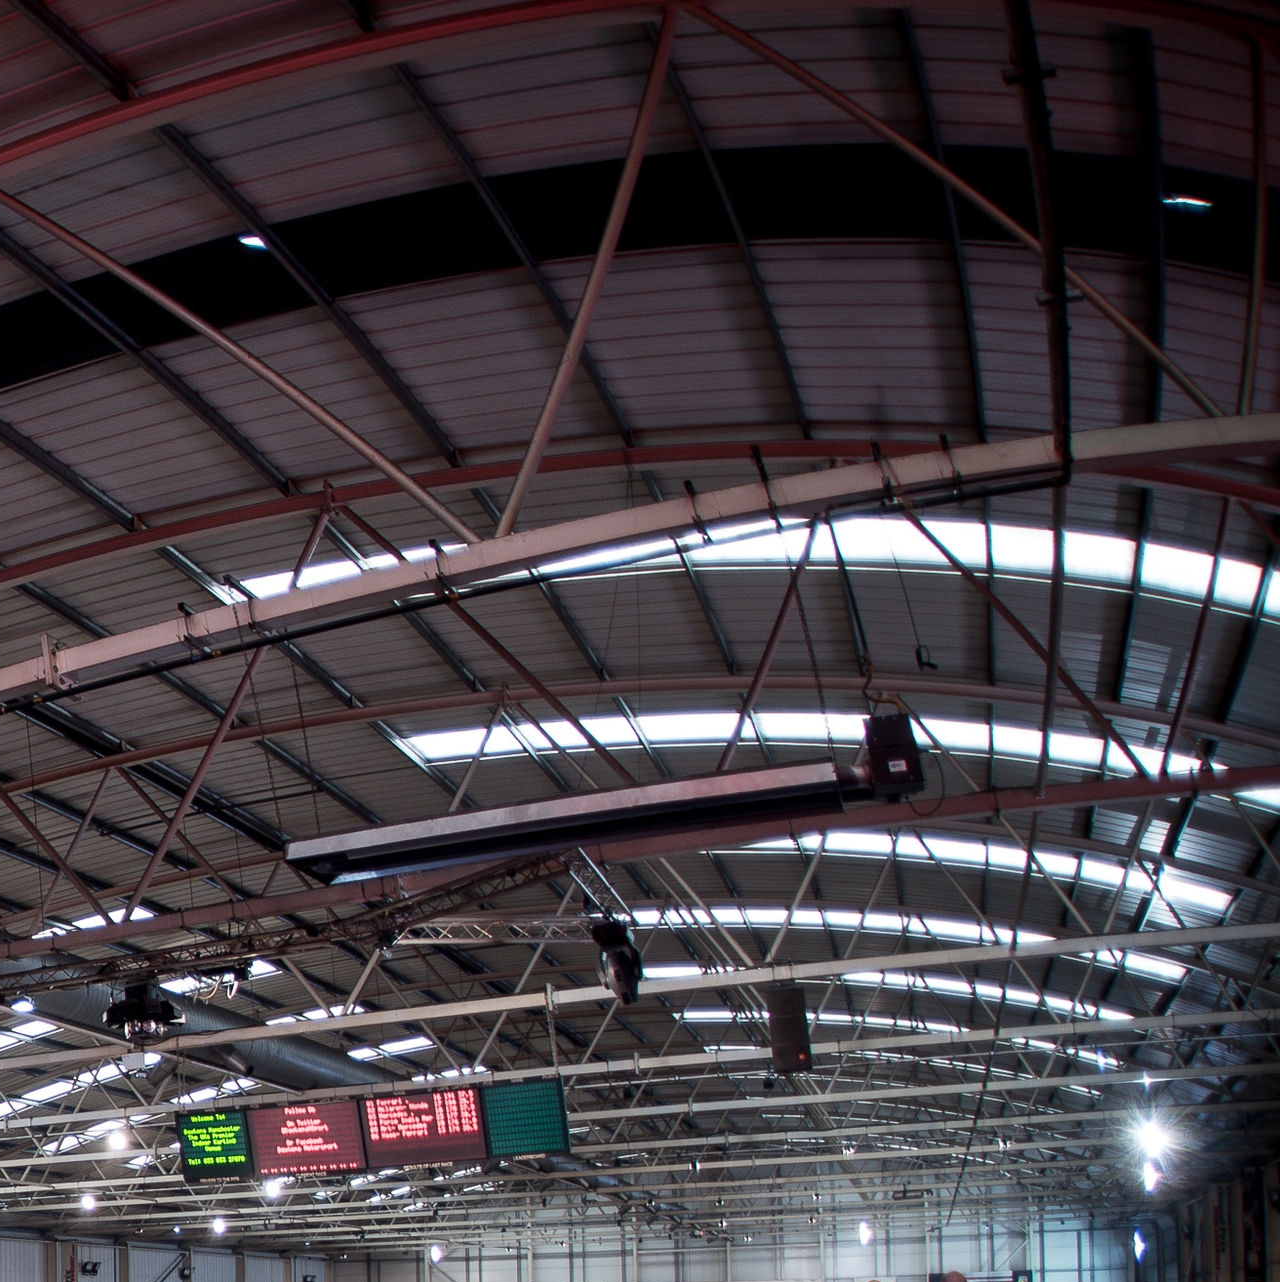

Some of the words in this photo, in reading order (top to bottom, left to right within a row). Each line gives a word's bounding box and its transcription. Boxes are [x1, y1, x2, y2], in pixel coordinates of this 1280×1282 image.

[284, 1107, 306, 1115] Follow
[208, 1125, 240, 1133] Manchester
[295, 1137, 323, 1145] Facebook
[277, 1146, 302, 1154] Daytona
